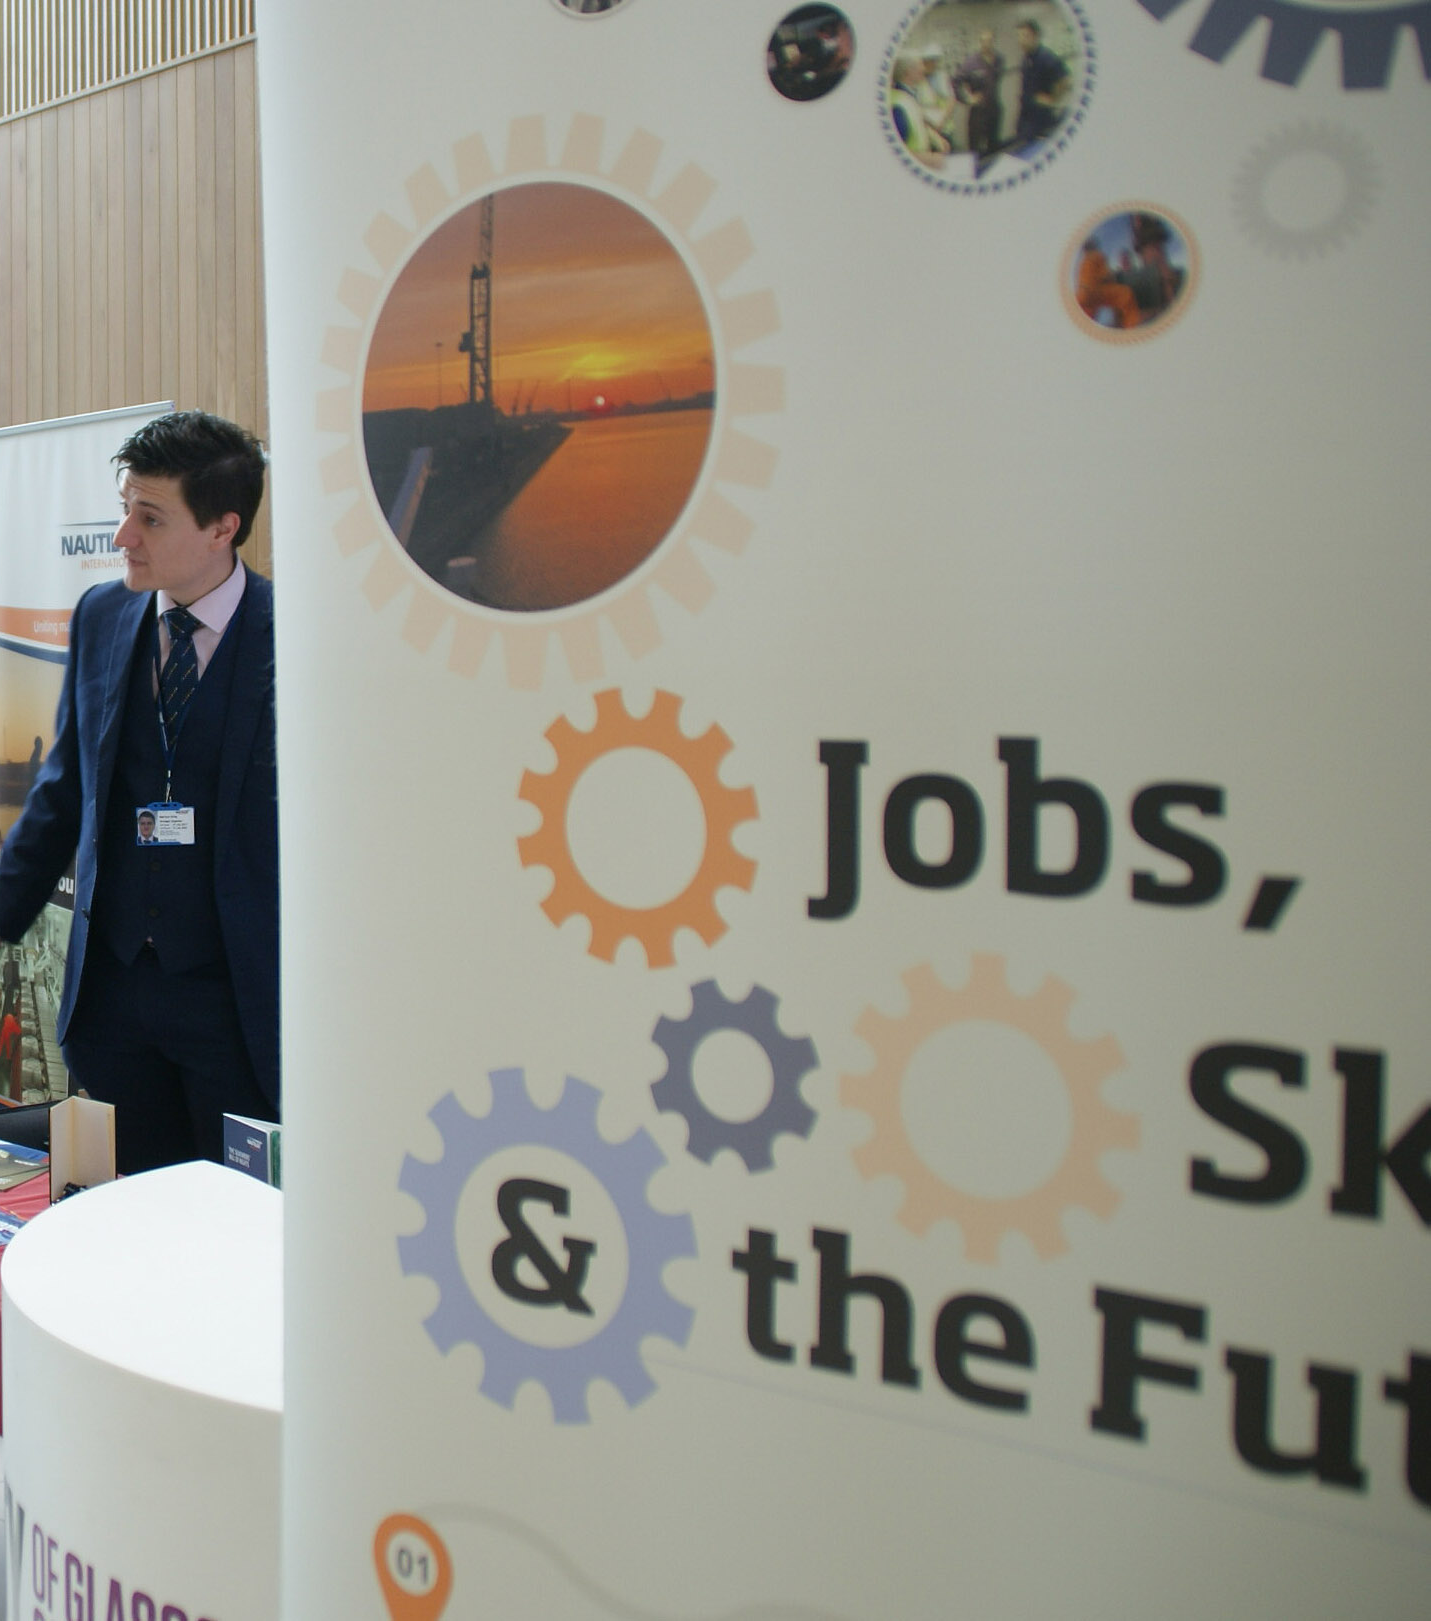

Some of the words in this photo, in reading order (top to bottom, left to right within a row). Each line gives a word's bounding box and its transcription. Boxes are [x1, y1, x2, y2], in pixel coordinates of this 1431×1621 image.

[61, 531, 121, 555] NAUTIL
[81, 557, 126, 570] INTERNATIO
[807, 736, 1302, 932] Jobs,
[491, 1177, 597, 1318] &
[732, 1225, 1038, 1417] the
[33, 1523, 59, 1613] OF
[397, 1547, 430, 1586] 01
